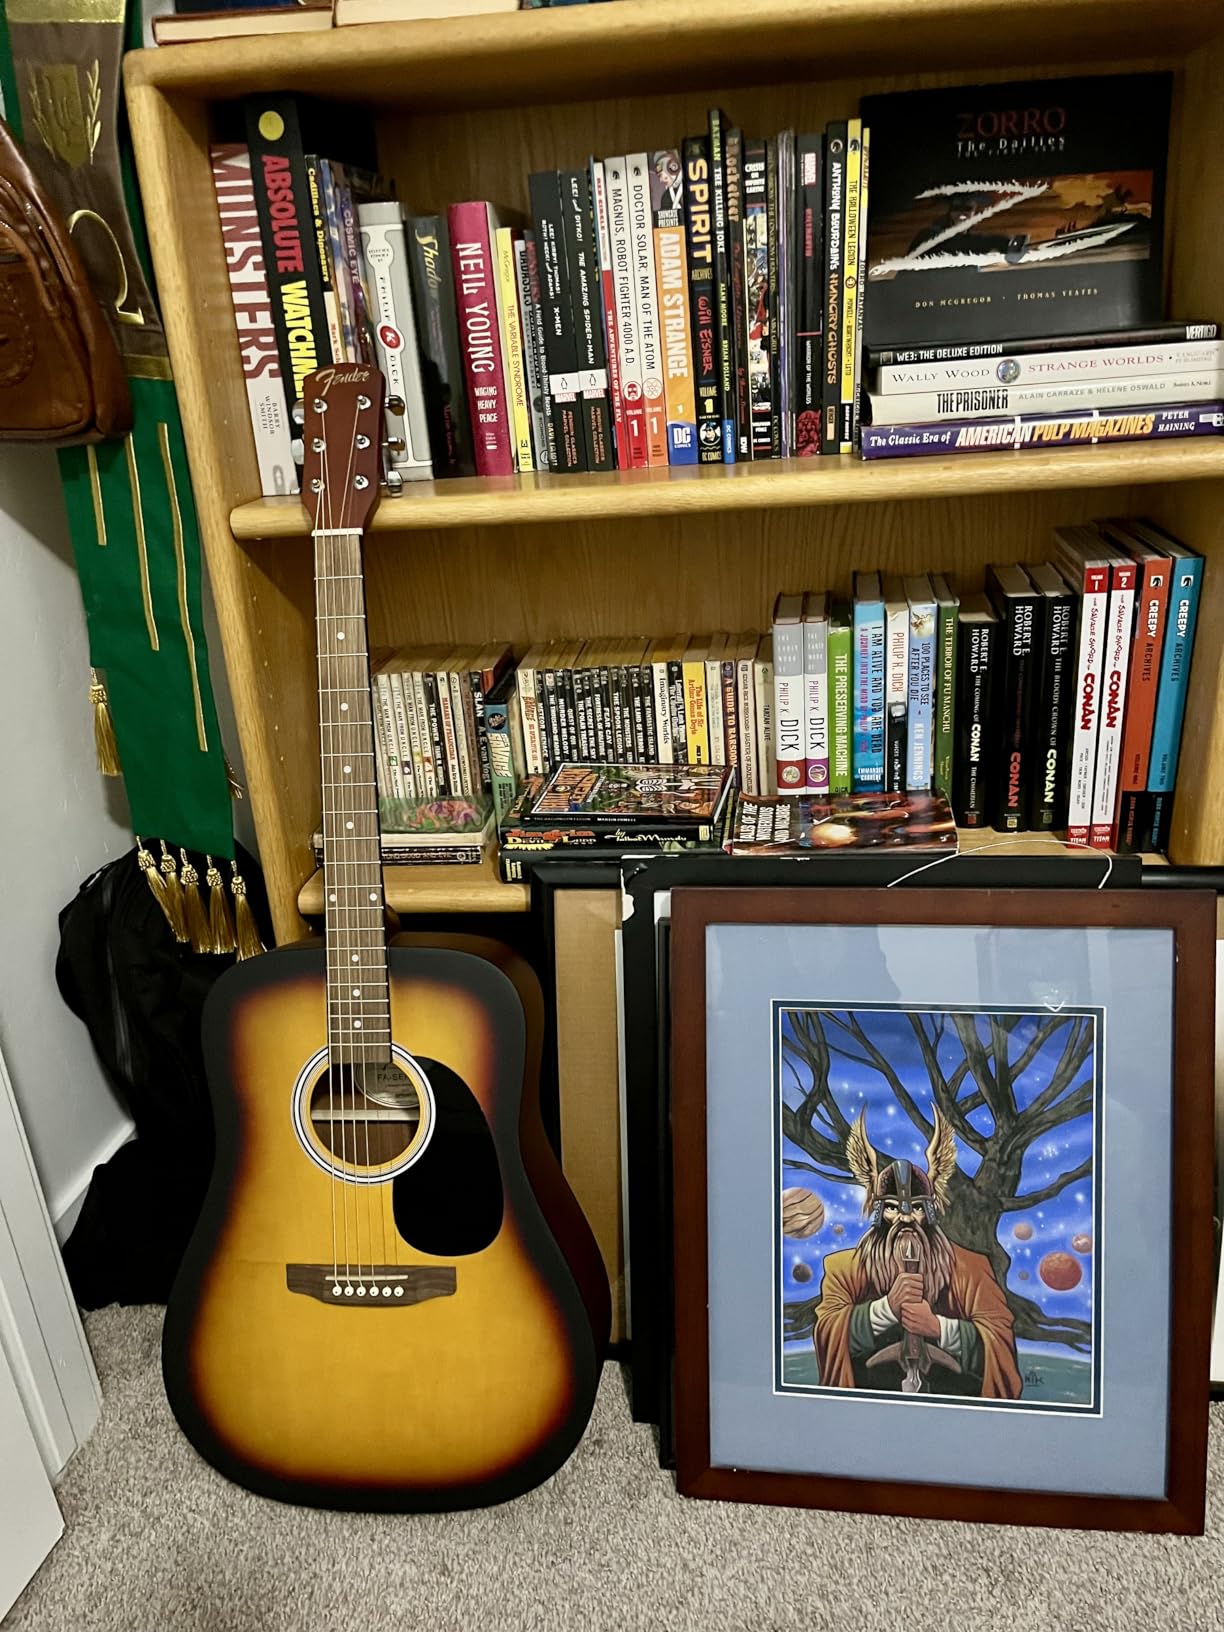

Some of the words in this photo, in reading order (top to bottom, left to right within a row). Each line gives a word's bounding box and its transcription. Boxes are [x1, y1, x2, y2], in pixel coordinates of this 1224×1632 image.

[714, 168, 722, 186] THE
[745, 161, 765, 173] CRISIS
[829, 162, 842, 209] ANTHONY
[848, 180, 858, 193] THE
[262, 155, 304, 272] ABSOLUTE
[633, 185, 645, 229] DOCTOR
[688, 158, 712, 264] SPIRIT
[714, 188, 724, 228] KILLING
[847, 196, 857, 238] HALLOWEEN
[343, 209, 357, 257] COSMIC
[715, 230, 725, 253] JOKE
[577, 251, 586, 267] THE
[616, 239, 628, 273] ROBOT
[659, 233, 683, 289] ADAM
[847, 241, 856, 266] LEGION
[456, 242, 486, 295] NEIL
[579, 269, 590, 306] AMAZING
[618, 276, 631, 318] FIGHTER
[640, 276, 651, 299] MAN
[507, 305, 515, 320] THE
[553, 307, 563, 336] X-MEN
[642, 303, 652, 316] OF
[281, 281, 319, 399] WATCHM
[466, 302, 495, 373] YOUNG
[508, 320, 520, 357] VARIABLE
[536, 326, 545, 345] Guide
[583, 309, 595, 364] SPIDER-MAN
[622, 321, 634, 345] 4000
[643, 319, 654, 339] THE
[661, 292, 688, 378] STRANGE
[919, 350, 934, 361] THE
[936, 347, 967, 359] DELUXE
[969, 344, 1003, 357] EDITION
[1185, 324, 1217, 340] VERTIGO
[625, 348, 635, 367] A.D.
[644, 343, 655, 370] ATOM
[827, 331, 837, 384] GHOSTS
[1029, 360, 1098, 373] STRANGE
[1103, 355, 1164, 367] WORLDS
[315, 366, 370, 397] Fender
[512, 359, 524, 406] SYNDROME
[477, 399, 496, 410] HEAVY
[937, 392, 954, 414] THE
[955, 389, 1009, 412] PRISONER
[1018, 392, 1044, 400] ALAIN
[1130, 382, 1166, 392] OSWALD
[479, 413, 498, 423] PEACE
[650, 416, 658, 435] 1
[1158, 422, 1195, 432] HAINING
[1161, 411, 1189, 420] PETER
[630, 419, 639, 437] 1
[673, 427, 691, 444] DC
[725, 424, 731, 433] DC
[870, 436, 886, 447] The
[888, 433, 920, 446] Classic
[922, 432, 939, 443] Era
[941, 431, 951, 444] of
[955, 425, 1034, 447] AMERICAN
[1032, 422, 1072, 442] PULP
[1070, 414, 1156, 440] MAGAZINES
[740, 436, 748, 454] IDW
[1120, 577, 1128, 588] 2
[944, 617, 954, 635] THE
[1012, 605, 1024, 656] HOWARD
[1021, 605, 1033, 645] ROBERT
[1050, 605, 1062, 655] HOWARD
[1059, 605, 1071, 643] ROBERT
[1089, 607, 1099, 636] SAVAGE
[1116, 604, 1126, 633] SAVAGE
[1146, 599, 1160, 638] CREEPY
[1176, 599, 1190, 638] CREEPY
[871, 633, 883, 647] AM
[892, 632, 905, 659] PHILIP
[921, 642, 931, 655] 100
[969, 628, 980, 673] HOWARD
[980, 628, 989, 663] ROBERT
[1021, 647, 1031, 656] E.
[835, 653, 848, 673] THE
[871, 650, 883, 674] ALIVE
[910, 647, 920, 670] AFTER
[943, 636, 953, 669] TERROR
[1142, 642, 1154, 682] ARCHIVES
[1170, 642, 1184, 682] ARCHIVES
[910, 673, 920, 687] YOU
[920, 656, 930, 681] PLACES
[943, 669, 953, 682] OF
[979, 665, 988, 673] E.
[778, 681, 789, 706] PHILIP
[808, 680, 819, 703] PHILIP
[871, 677, 883, 694] AND
[892, 672, 904, 693] DICK
[920, 682, 930, 692] TO
[943, 683, 953, 694] FU
[1051, 674, 1062, 705] BLOODY
[473, 691, 485, 717] SLAN
[548, 694, 556, 705] THE
[577, 700, 585, 711] THE
[612, 691, 620, 706] THE
[633, 696, 641, 708] THE
[658, 677, 668, 717] Imaginary
[726, 686, 736, 713] GUIDE
[871, 697, 883, 713] YOU
[910, 689, 920, 701] DIE
[920, 693, 930, 705] SEE
[1080, 672, 1096, 731] CONAN
[1106, 670, 1123, 728] CONAN
[429, 703, 437, 717] THE
[558, 698, 567, 727] MURDER
[566, 708, 575, 726] QUEST
[578, 711, 586, 730] POLAR
[586, 708, 594, 729] SECRET
[603, 707, 612, 729] FEAR
[614, 706, 622, 730] SPOOK
[622, 706, 630, 719] THE
[727, 714, 736, 726] TO
[942, 695, 952, 733] MANCHU
[1050, 706, 1060, 735] CROWN
[431, 717, 440, 742] POWER
[569, 726, 576, 735] OF
[623, 719, 632, 748] MONSTERS
[636, 723, 643, 731] OF
[661, 719, 671, 745] Worlds
[779, 719, 800, 751] DICK
[809, 717, 825, 750] DICK
[871, 716, 883, 731] ARE
[913, 723, 925, 740] KEN
[560, 727, 569, 755] MELODY
[580, 730, 589, 757] TREASURE
[615, 730, 624, 754] LEGION
[728, 727, 738, 768] BARSOOM
[871, 733, 883, 754] DEAD
[970, 723, 982, 762] CONAN
[480, 745, 489, 762] van
[589, 747, 597, 760] SKY
[912, 741, 925, 781] JENNINGS
[481, 762, 491, 784] Vogt
[1007, 751, 1021, 807] CONAN
[1044, 748, 1058, 803] CONAN
[743, 801, 758, 815] THE
